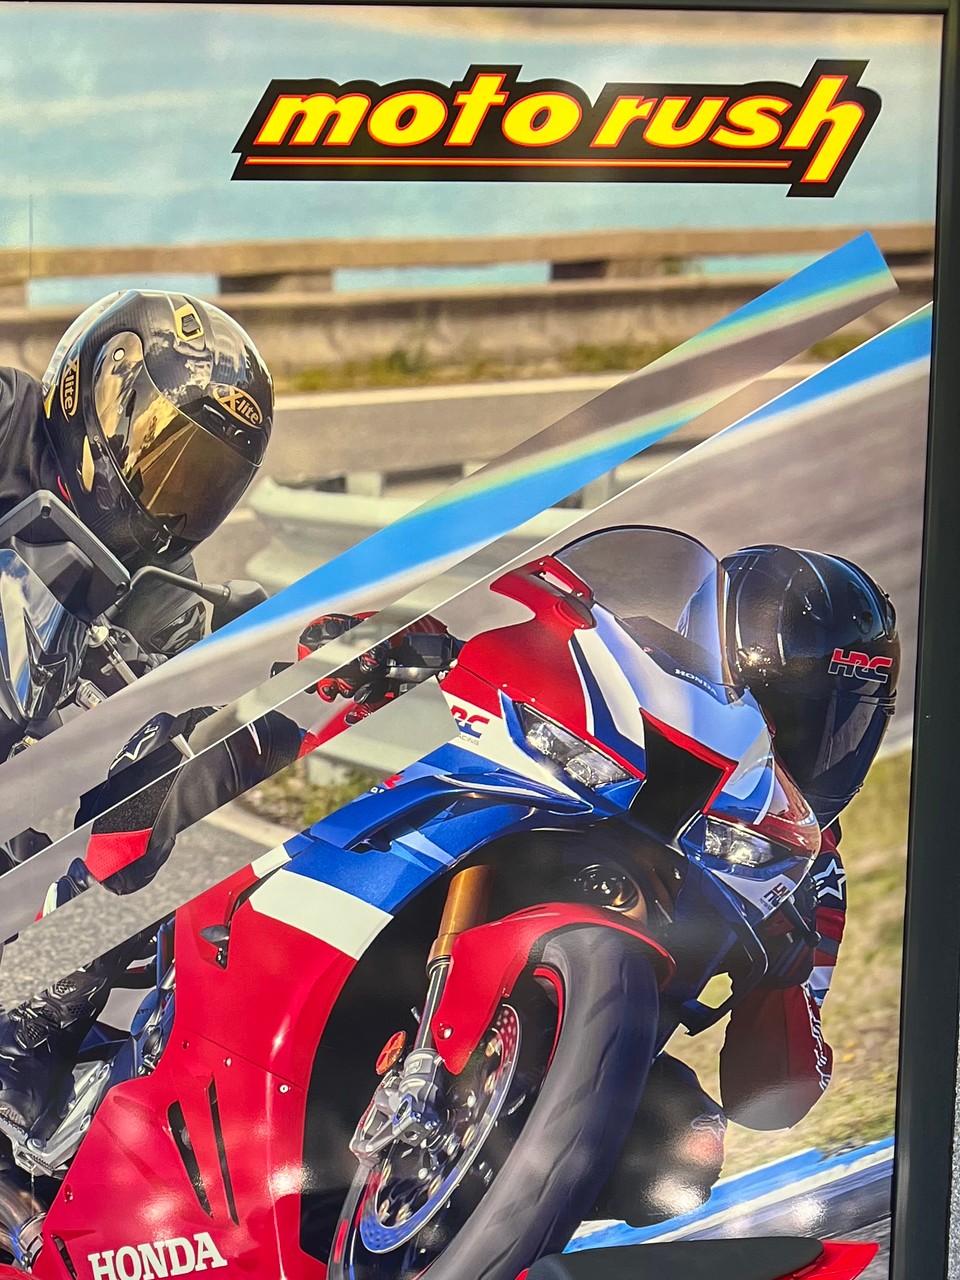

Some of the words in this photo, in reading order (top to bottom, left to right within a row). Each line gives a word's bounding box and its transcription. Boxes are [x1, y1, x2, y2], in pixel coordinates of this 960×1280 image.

[253, 72, 584, 148] moto
[589, 73, 867, 185] rush
[215, 385, 260, 425] X-lite
[674, 668, 719, 696] HONDA
[828, 647, 893, 684] HRC
[450, 704, 490, 739] RC
